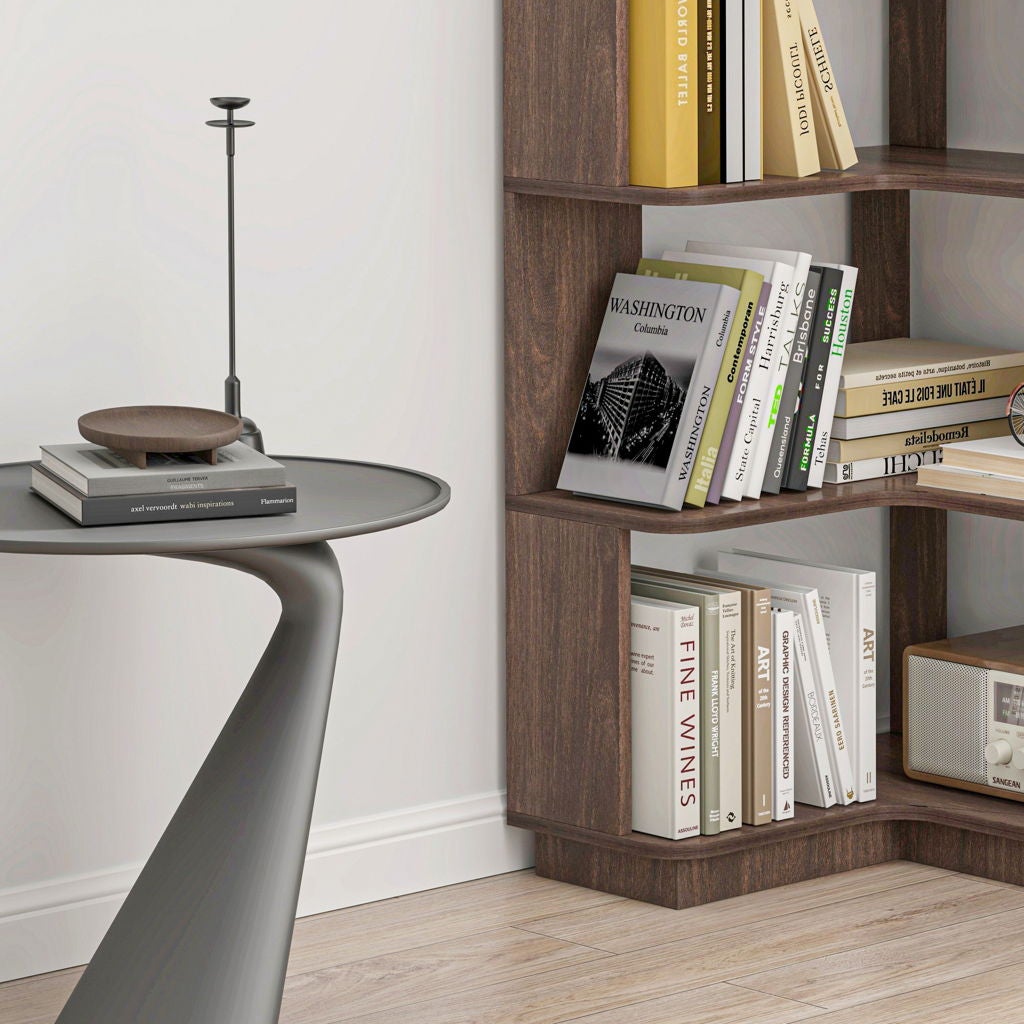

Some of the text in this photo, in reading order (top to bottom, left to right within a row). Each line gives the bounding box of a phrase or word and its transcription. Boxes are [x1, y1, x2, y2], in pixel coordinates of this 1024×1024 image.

[610, 297, 707, 324] WASHINGTON
[634, 322, 668, 336] Columbia
[735, 281, 790, 482] State Capital Harrisburg
[737, 306, 766, 404] FORM STYLE
[773, 288, 816, 478] Queensland Brisbane
[800, 288, 838, 471] FORMULA FOR SUCCESS
[815, 289, 853, 466] Tehas Houston
[678, 310, 731, 481] WASHINGTON Columbia
[694, 301, 754, 493] Italia Contemporan
[768, 384, 783, 429] TED
[131, 500, 234, 512] axel vervoordt wabi inspirations
[260, 497, 294, 505] Flammarion
[757, 646, 770, 681] ART
[863, 627, 875, 662] ART
[680, 640, 696, 807] FINE WINES
[992, 776, 1020, 789] SANGEAN
